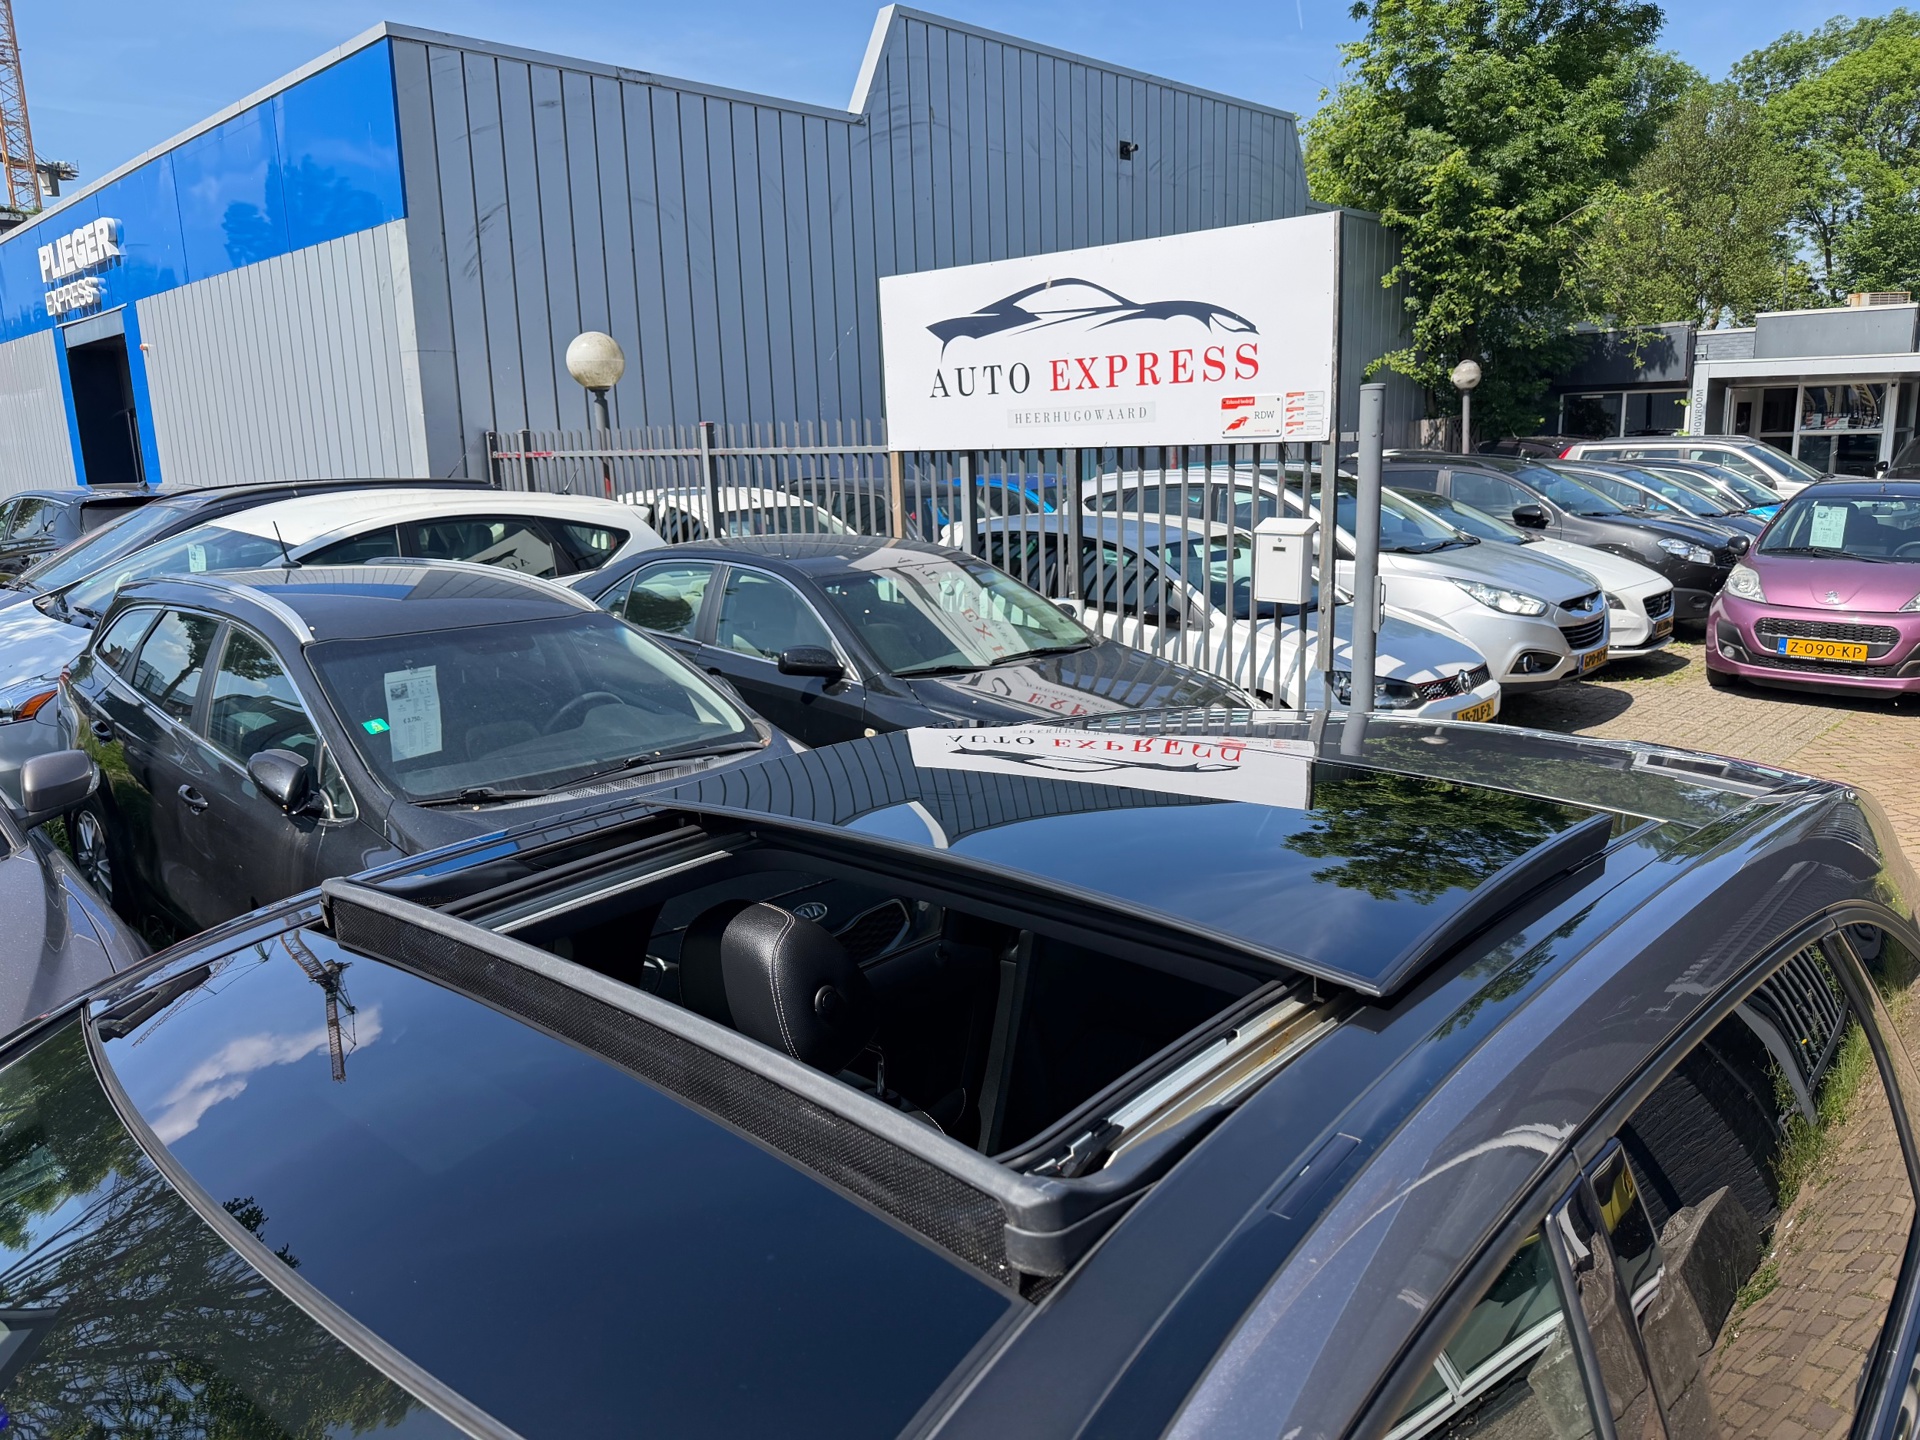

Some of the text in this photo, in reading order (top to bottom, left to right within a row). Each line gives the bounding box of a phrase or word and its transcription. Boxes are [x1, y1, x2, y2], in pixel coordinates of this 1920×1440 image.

[38, 217, 118, 283] PLIEGER
[45, 277, 100, 316] EXPRESS
[929, 343, 1260, 398] AUTO EXPRESS
[1014, 407, 1148, 424] HEERHUGOWAARD
[1254, 411, 1275, 419] RDW
[1790, 642, 1862, 658] Z-090-KP
